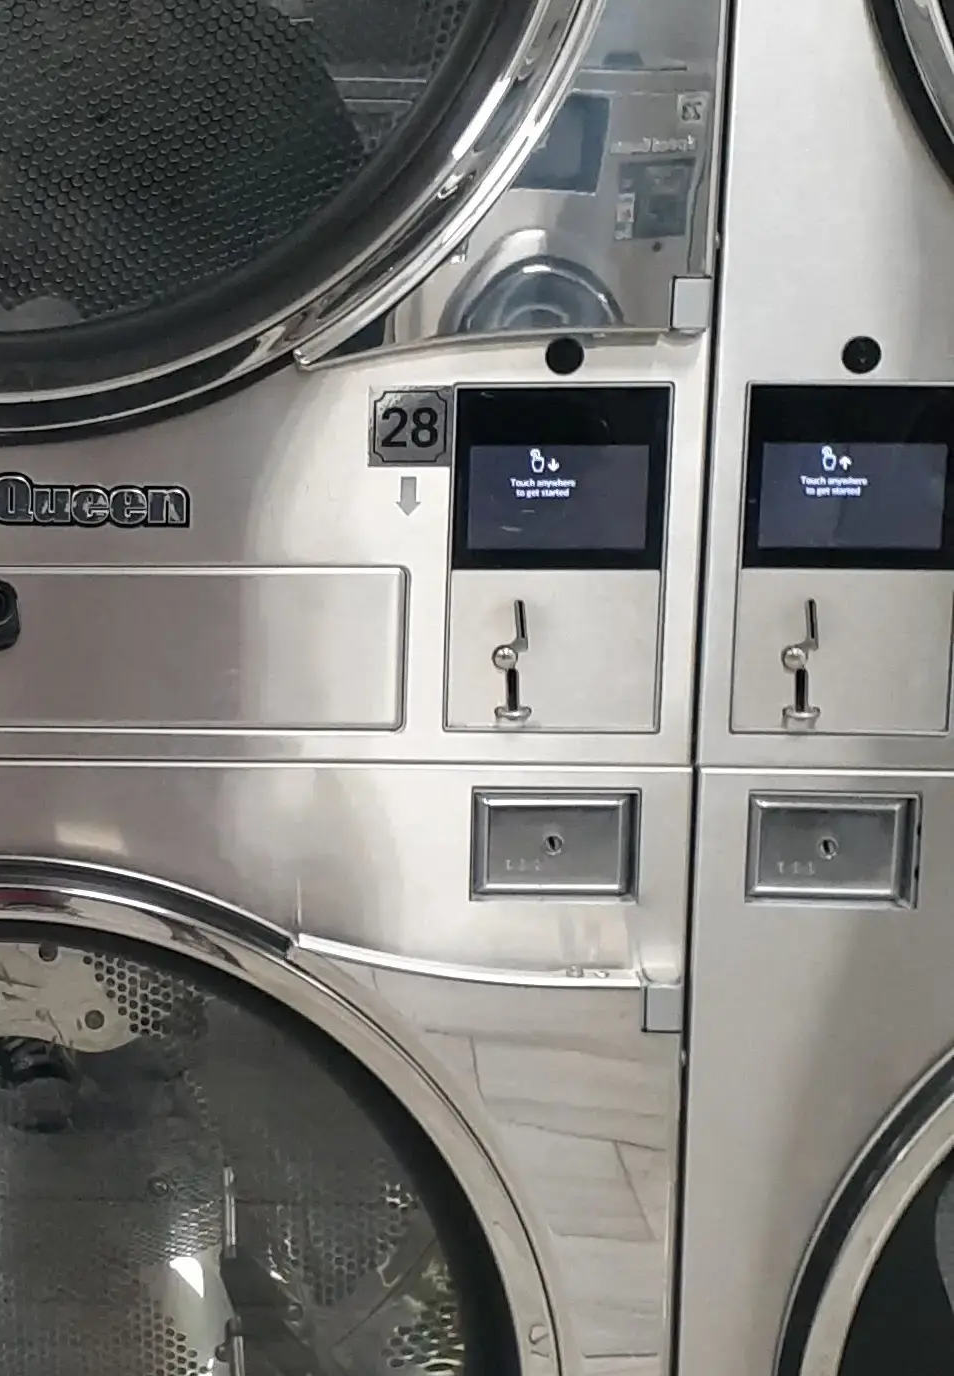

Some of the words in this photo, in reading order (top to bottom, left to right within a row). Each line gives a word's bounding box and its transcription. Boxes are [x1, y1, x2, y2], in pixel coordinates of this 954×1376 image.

[381, 407, 438, 448] 28
[510, 478, 535, 487] Touch
[537, 478, 576, 488] anywhere
[516, 489, 525, 497] to
[526, 489, 540, 498] get
[541, 488, 570, 497] started
